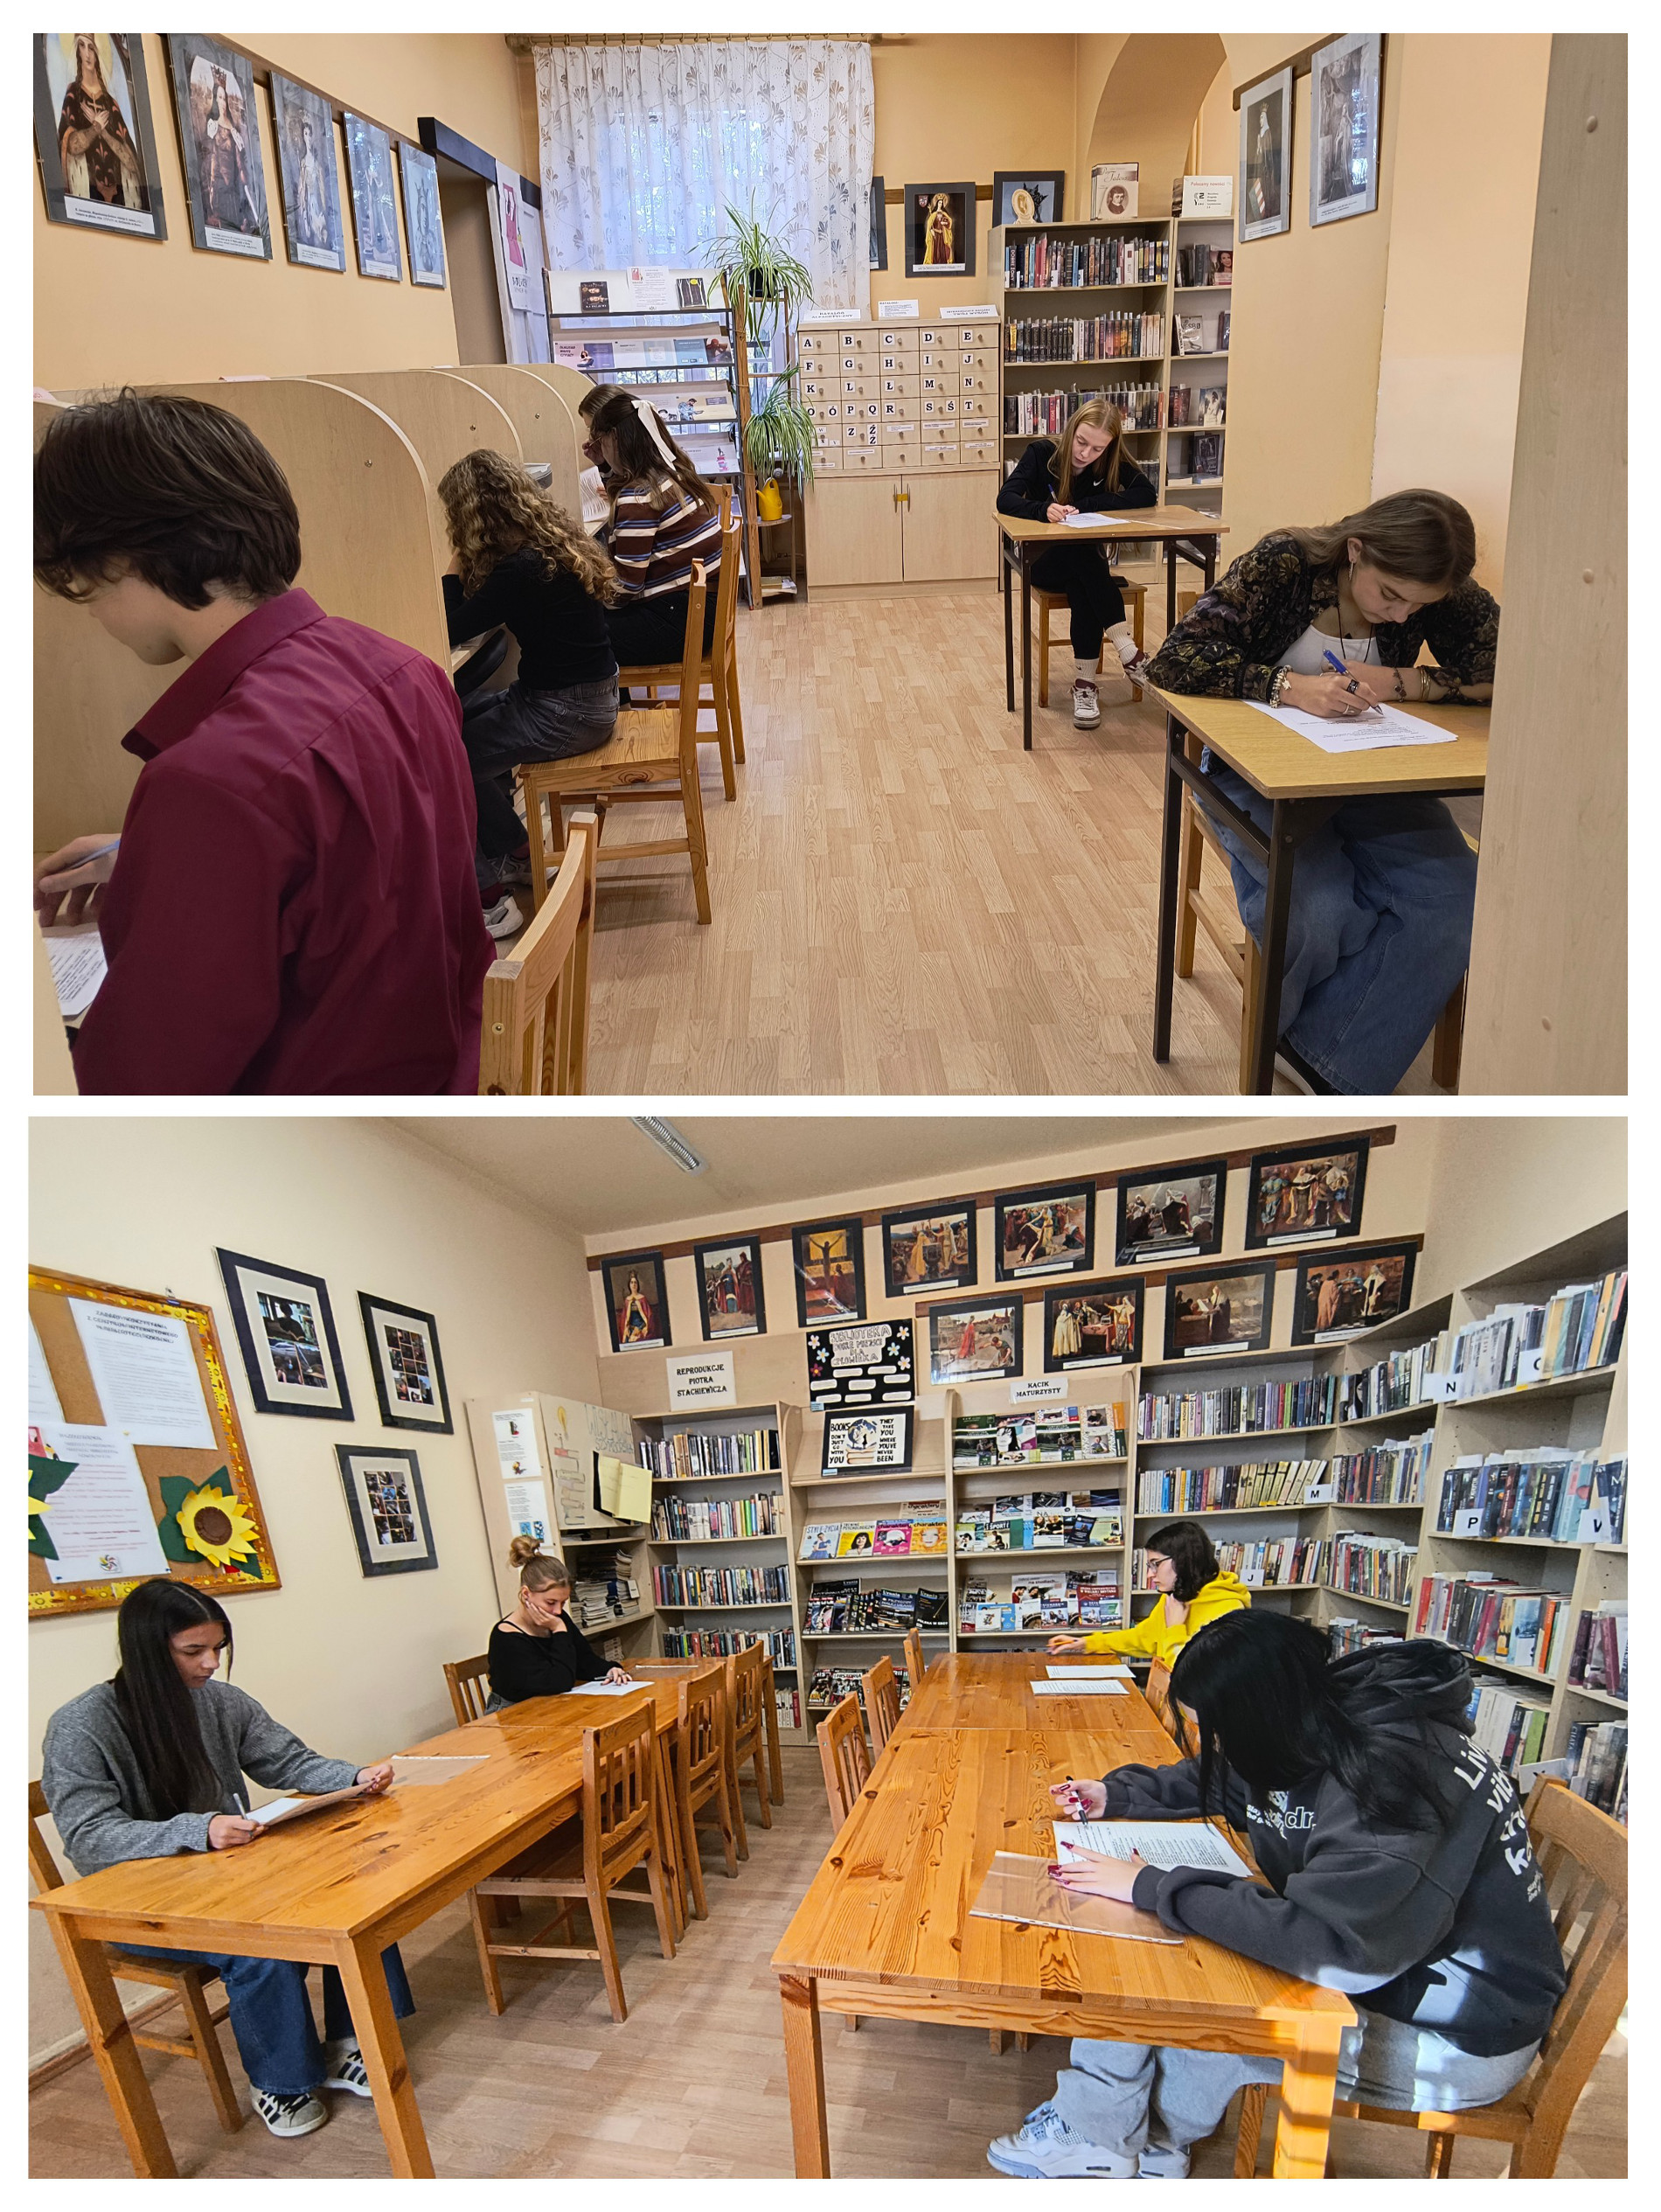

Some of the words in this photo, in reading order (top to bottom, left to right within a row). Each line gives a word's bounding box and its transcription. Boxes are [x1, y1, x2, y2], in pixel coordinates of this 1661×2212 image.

[829, 406, 836, 415] Ó
[869, 406, 876, 414] Q
[948, 401, 954, 410] Ś
[831, 1325, 890, 1344] BIBLIOTEKA
[677, 1364, 724, 1375] REPRODUKCJE
[689, 1376, 713, 1384] PIOTRA
[677, 1386, 727, 1397] STACHIEWICZA
[1016, 1387, 1061, 1397] MATURZYSTY
[1446, 1382, 1456, 1393] N
[830, 1422, 851, 1431] BOOKS
[1468, 1518, 1478, 1528] P
